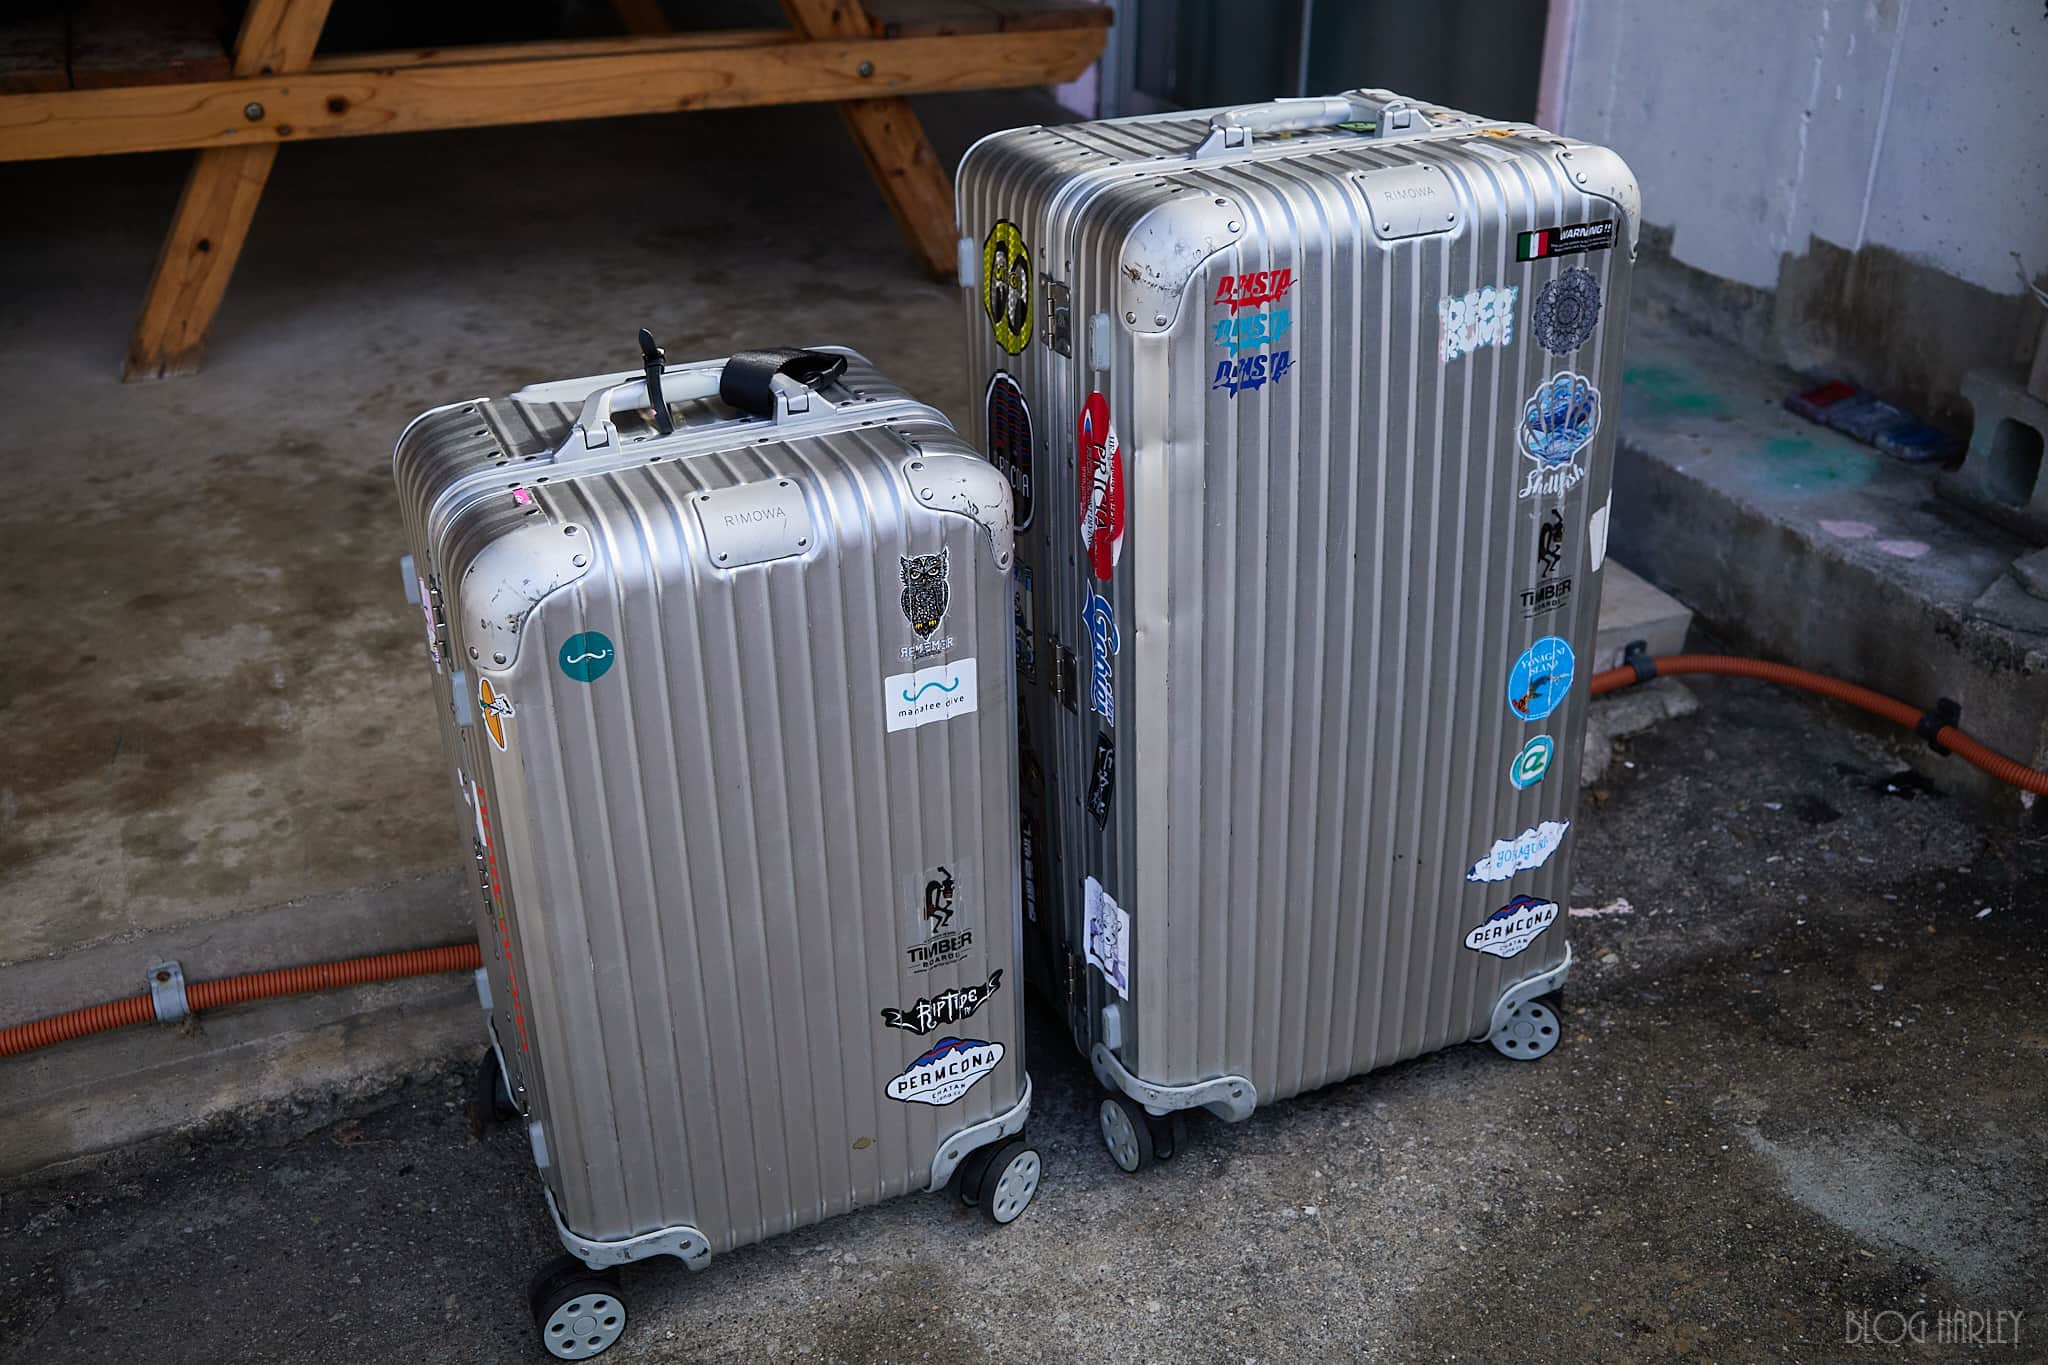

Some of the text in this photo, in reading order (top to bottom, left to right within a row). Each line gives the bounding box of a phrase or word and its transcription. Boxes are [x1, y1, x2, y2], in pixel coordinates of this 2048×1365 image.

[1383, 186, 1435, 201] RIMOWA
[1519, 464, 1584, 498] Shellfish
[724, 506, 786, 527] RIMOWA
[1521, 646, 1566, 669] YONAGNI
[1530, 659, 1558, 675] SLAND
[898, 695, 964, 717] manatee dive
[1473, 909, 1553, 944] PERMCONA
[907, 932, 972, 962] TIMBER
[897, 1050, 995, 1094] PERMCONA
